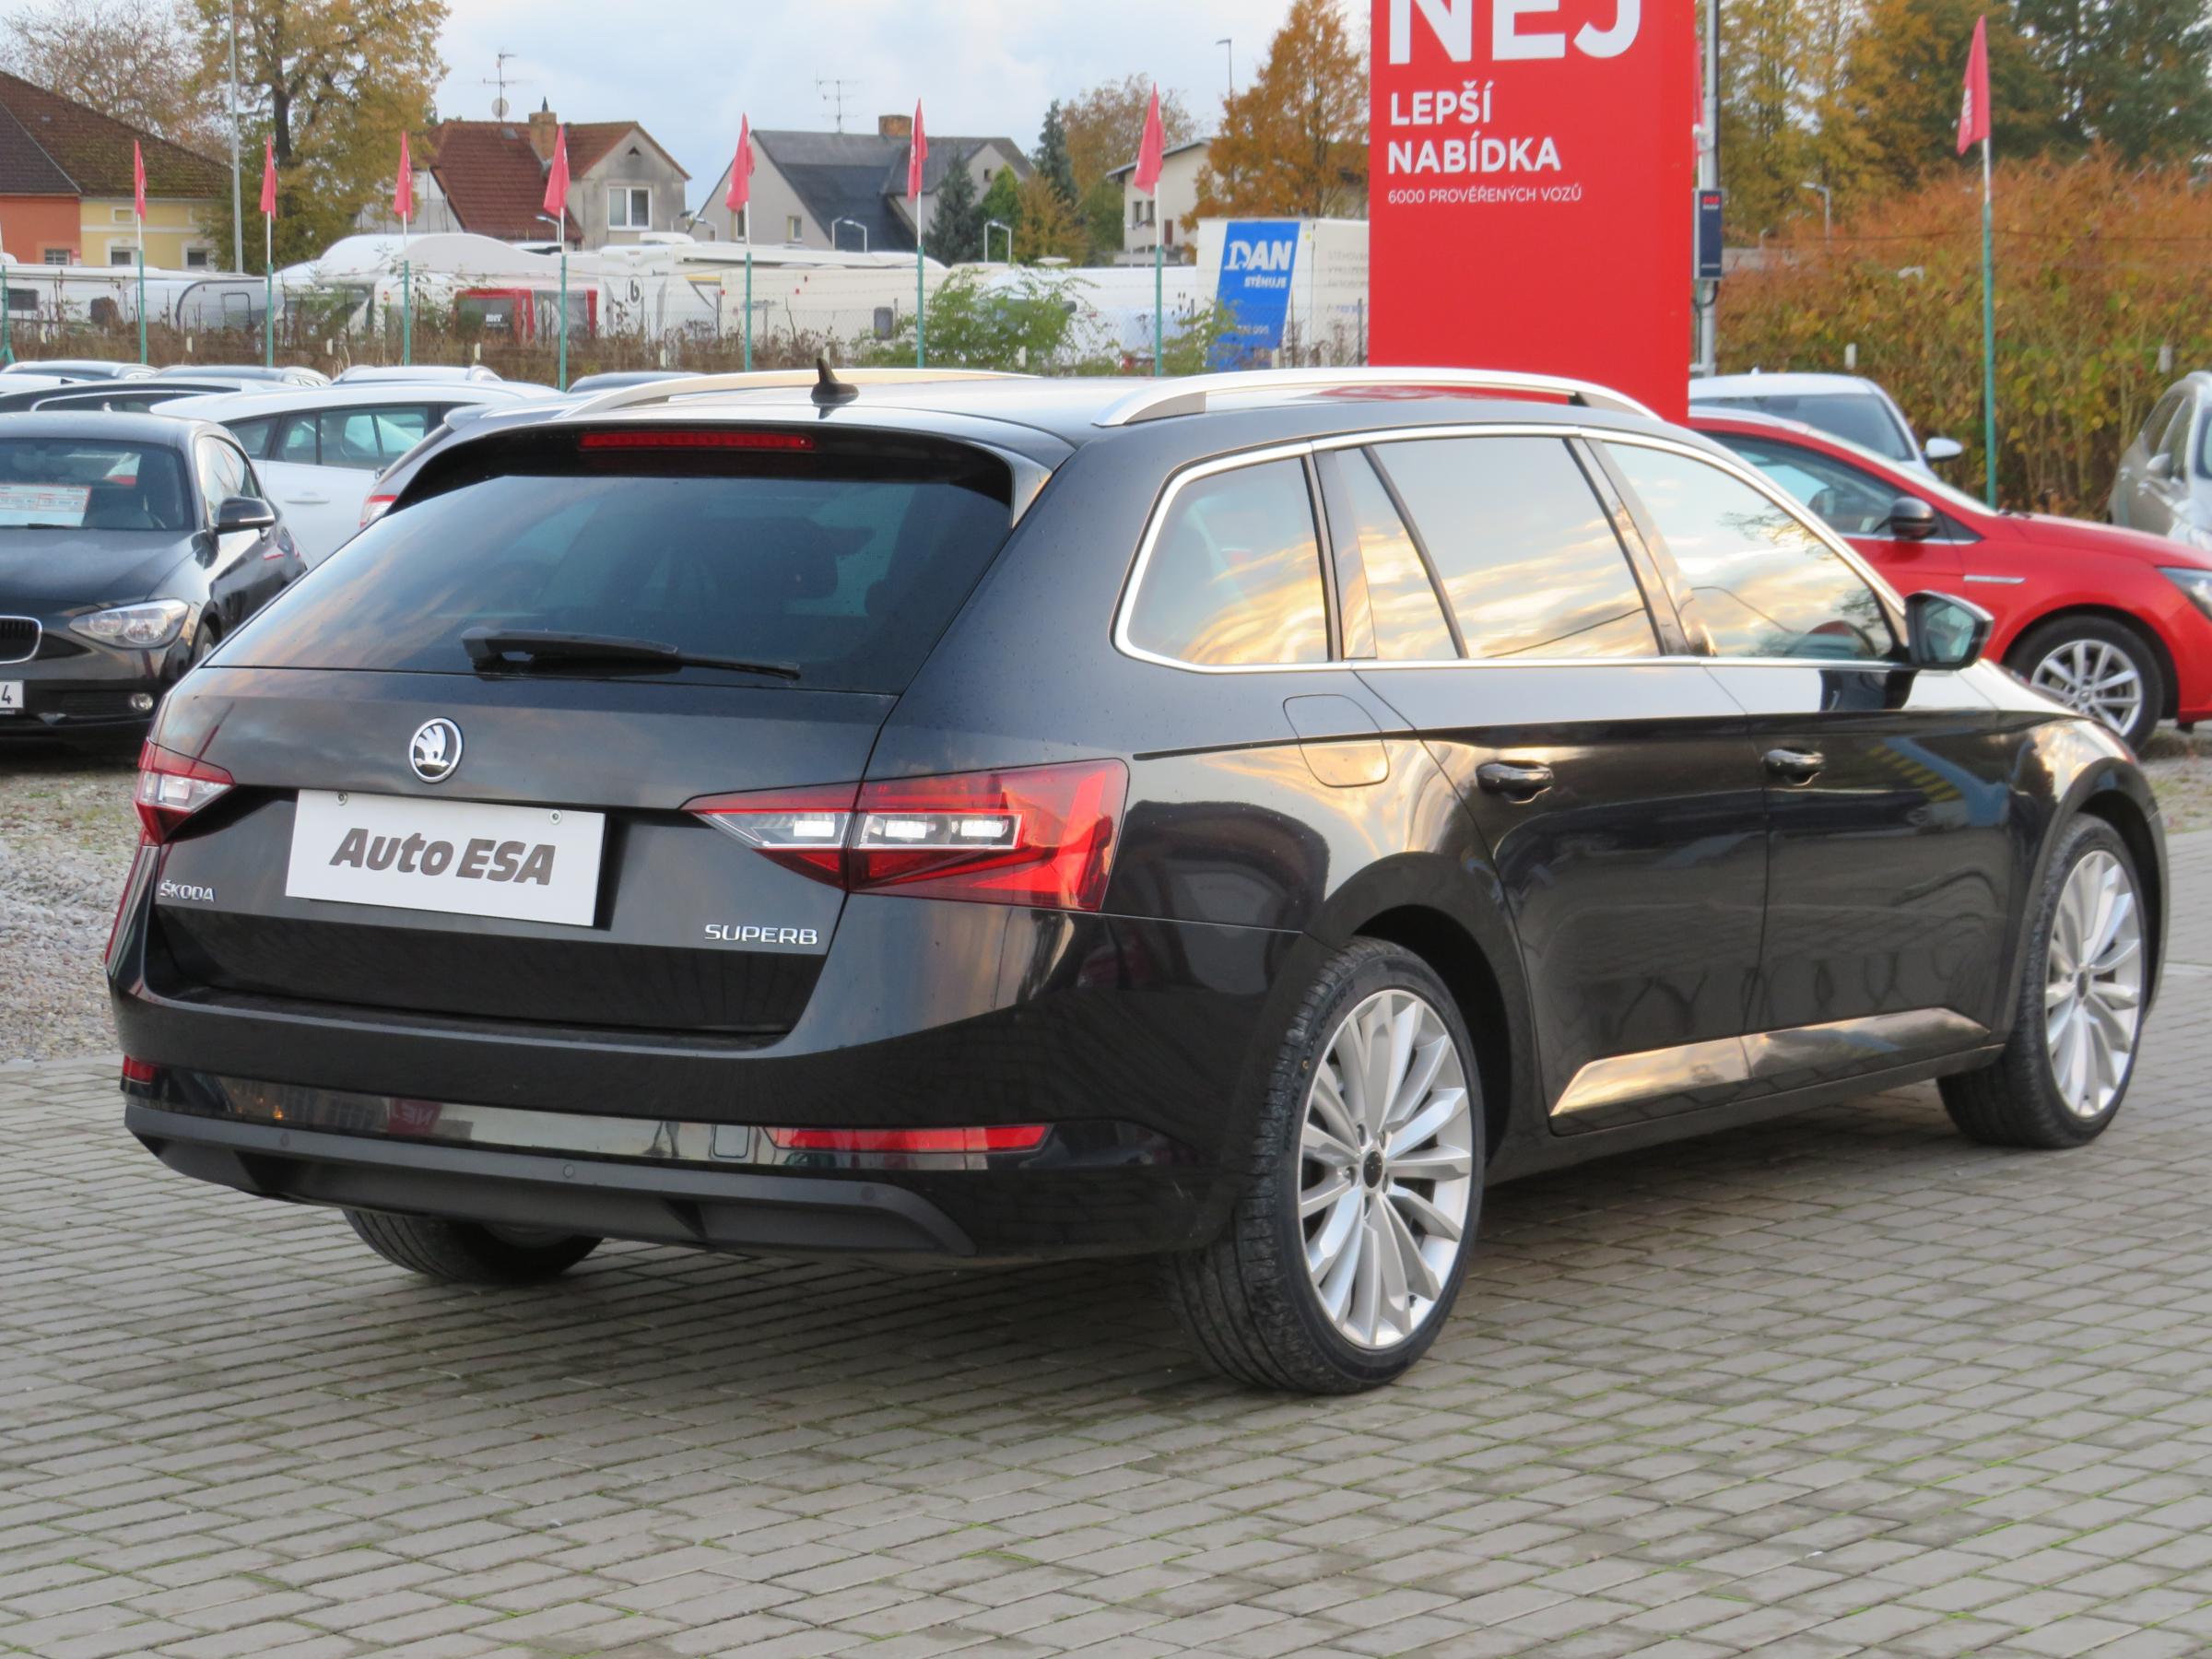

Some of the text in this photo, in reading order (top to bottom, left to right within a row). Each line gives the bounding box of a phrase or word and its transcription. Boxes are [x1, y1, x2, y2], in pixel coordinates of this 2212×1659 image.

[1389, 0, 1641, 65] NEJ
[1390, 80, 1493, 125] LEPŠÍ
[1387, 130, 1561, 174] NABÍDKA
[1388, 182, 1582, 204] 6000 PROVĚŘENÝCH VOZŮ
[1224, 241, 1292, 270] DAN
[329, 828, 556, 885] Auto ESA
[159, 879, 215, 903] ŠKODA
[704, 924, 818, 945] SUPERB
